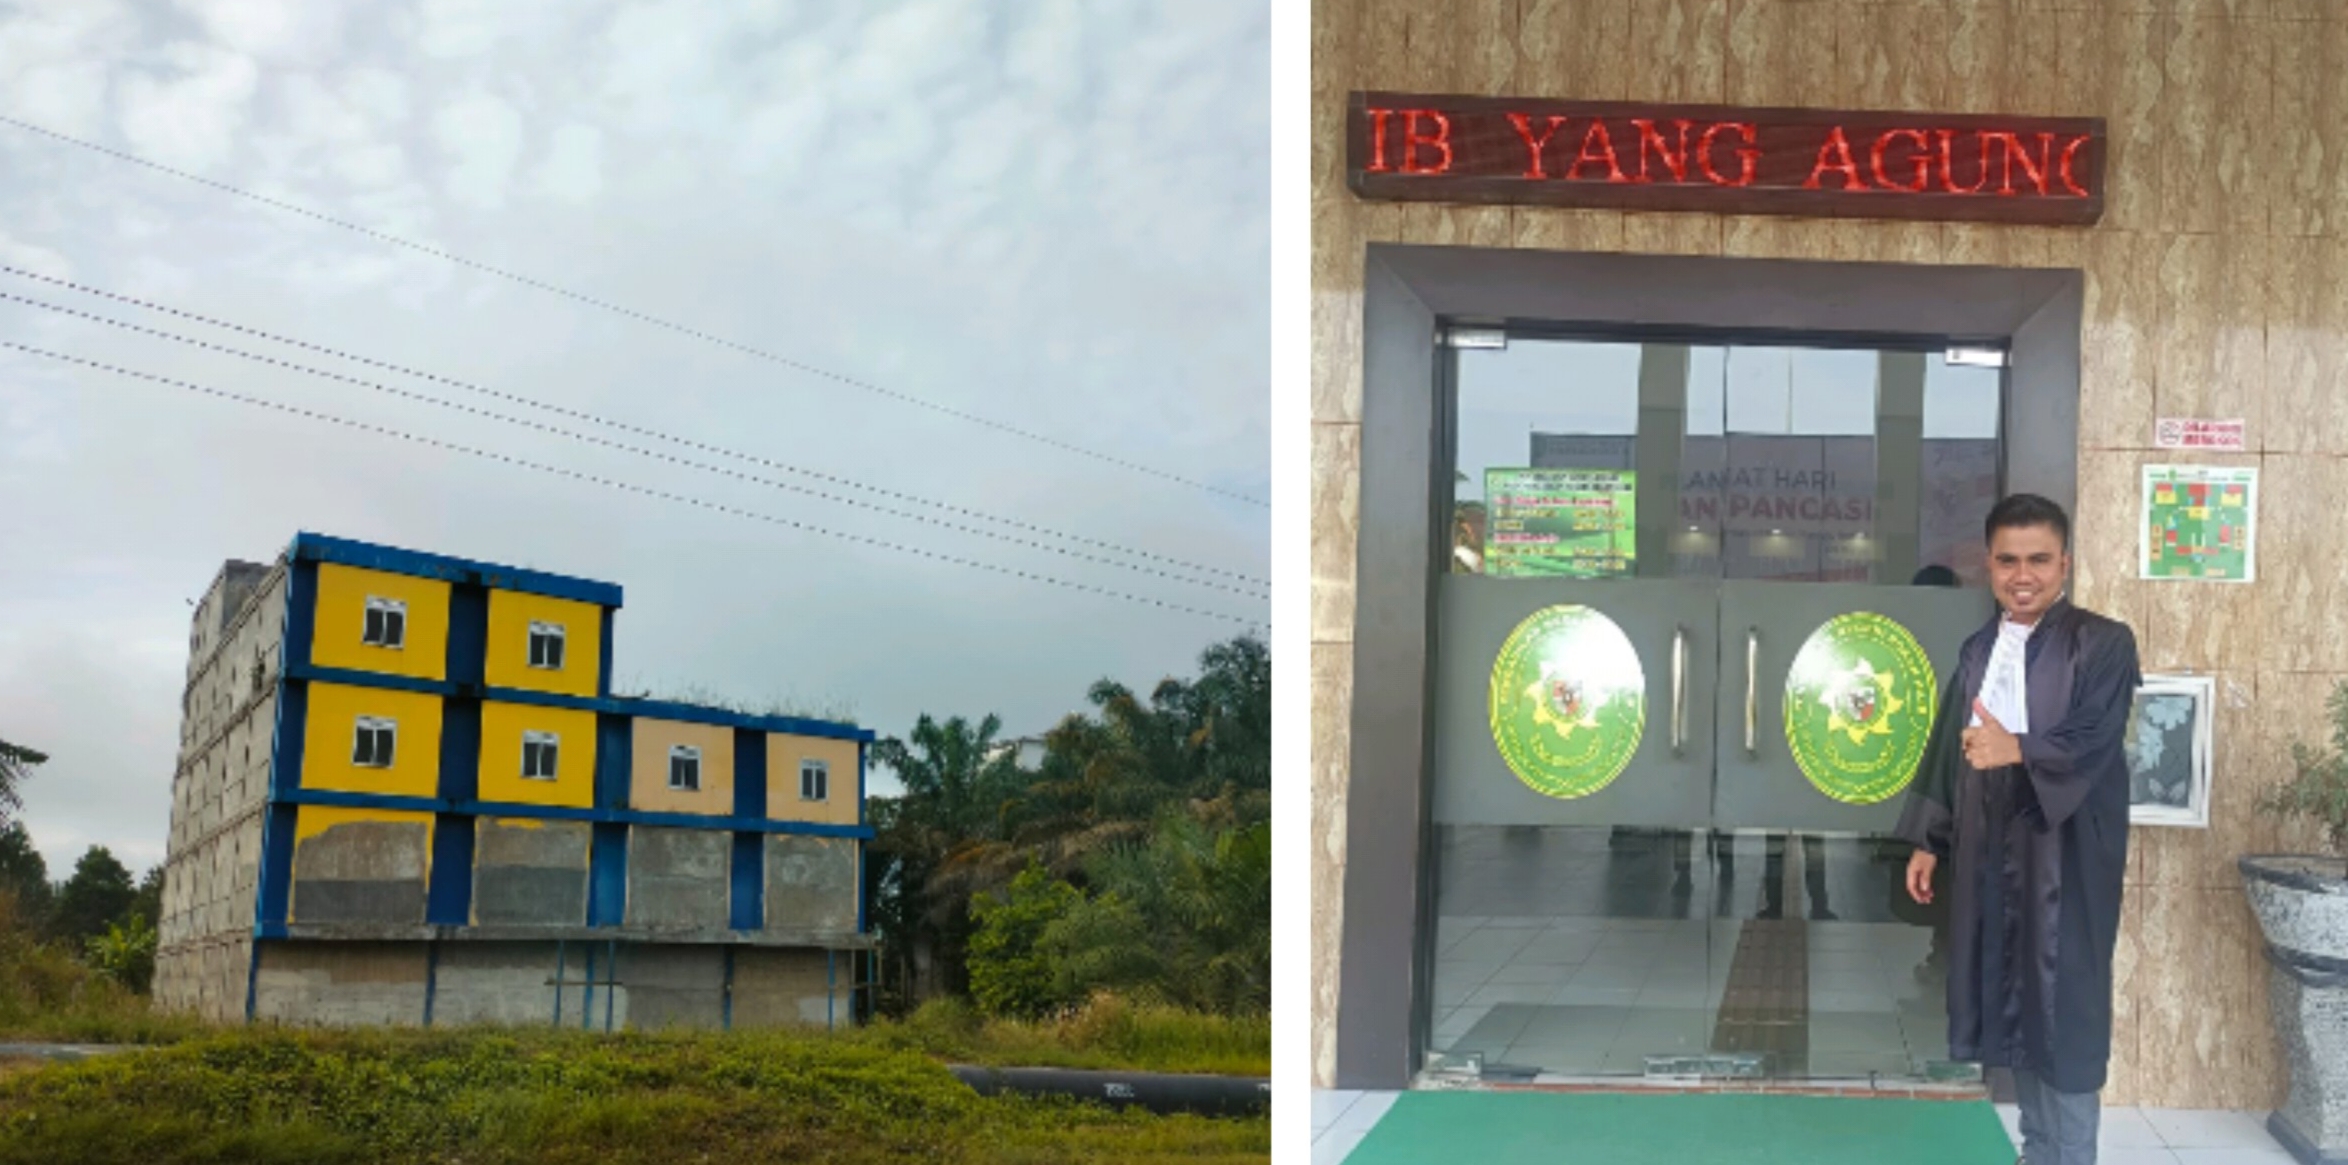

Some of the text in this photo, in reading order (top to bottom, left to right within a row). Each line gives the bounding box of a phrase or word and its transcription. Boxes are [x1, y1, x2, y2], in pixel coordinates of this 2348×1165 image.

[1366, 107, 1454, 175] IB
[1506, 111, 1761, 187] YANG
[1775, 468, 1836, 490] HARI
[1729, 493, 1874, 522] PANCASI
